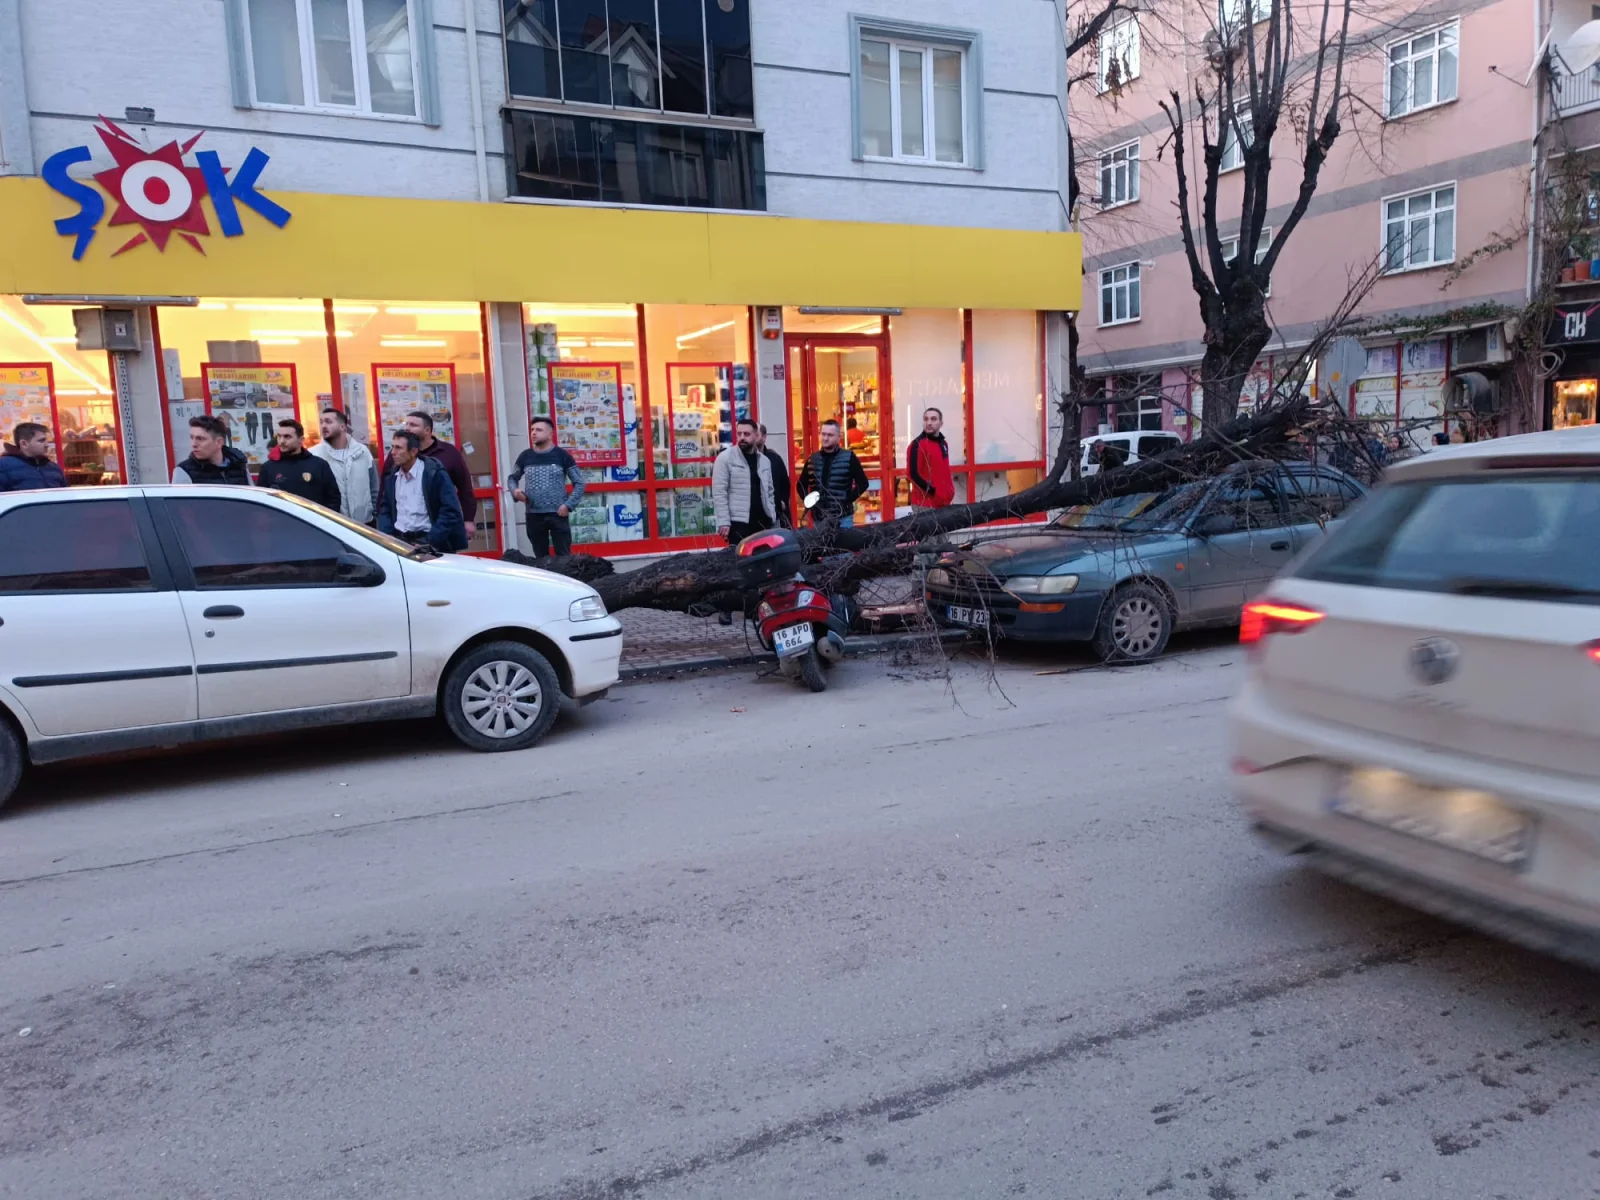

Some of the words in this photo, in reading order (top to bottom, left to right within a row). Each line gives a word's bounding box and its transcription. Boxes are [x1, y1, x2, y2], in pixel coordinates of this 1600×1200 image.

[42, 145, 291, 261] ŞOK
[951, 607, 958, 619] 16
[776, 630, 788, 641] 16
[785, 636, 802, 648] 664
